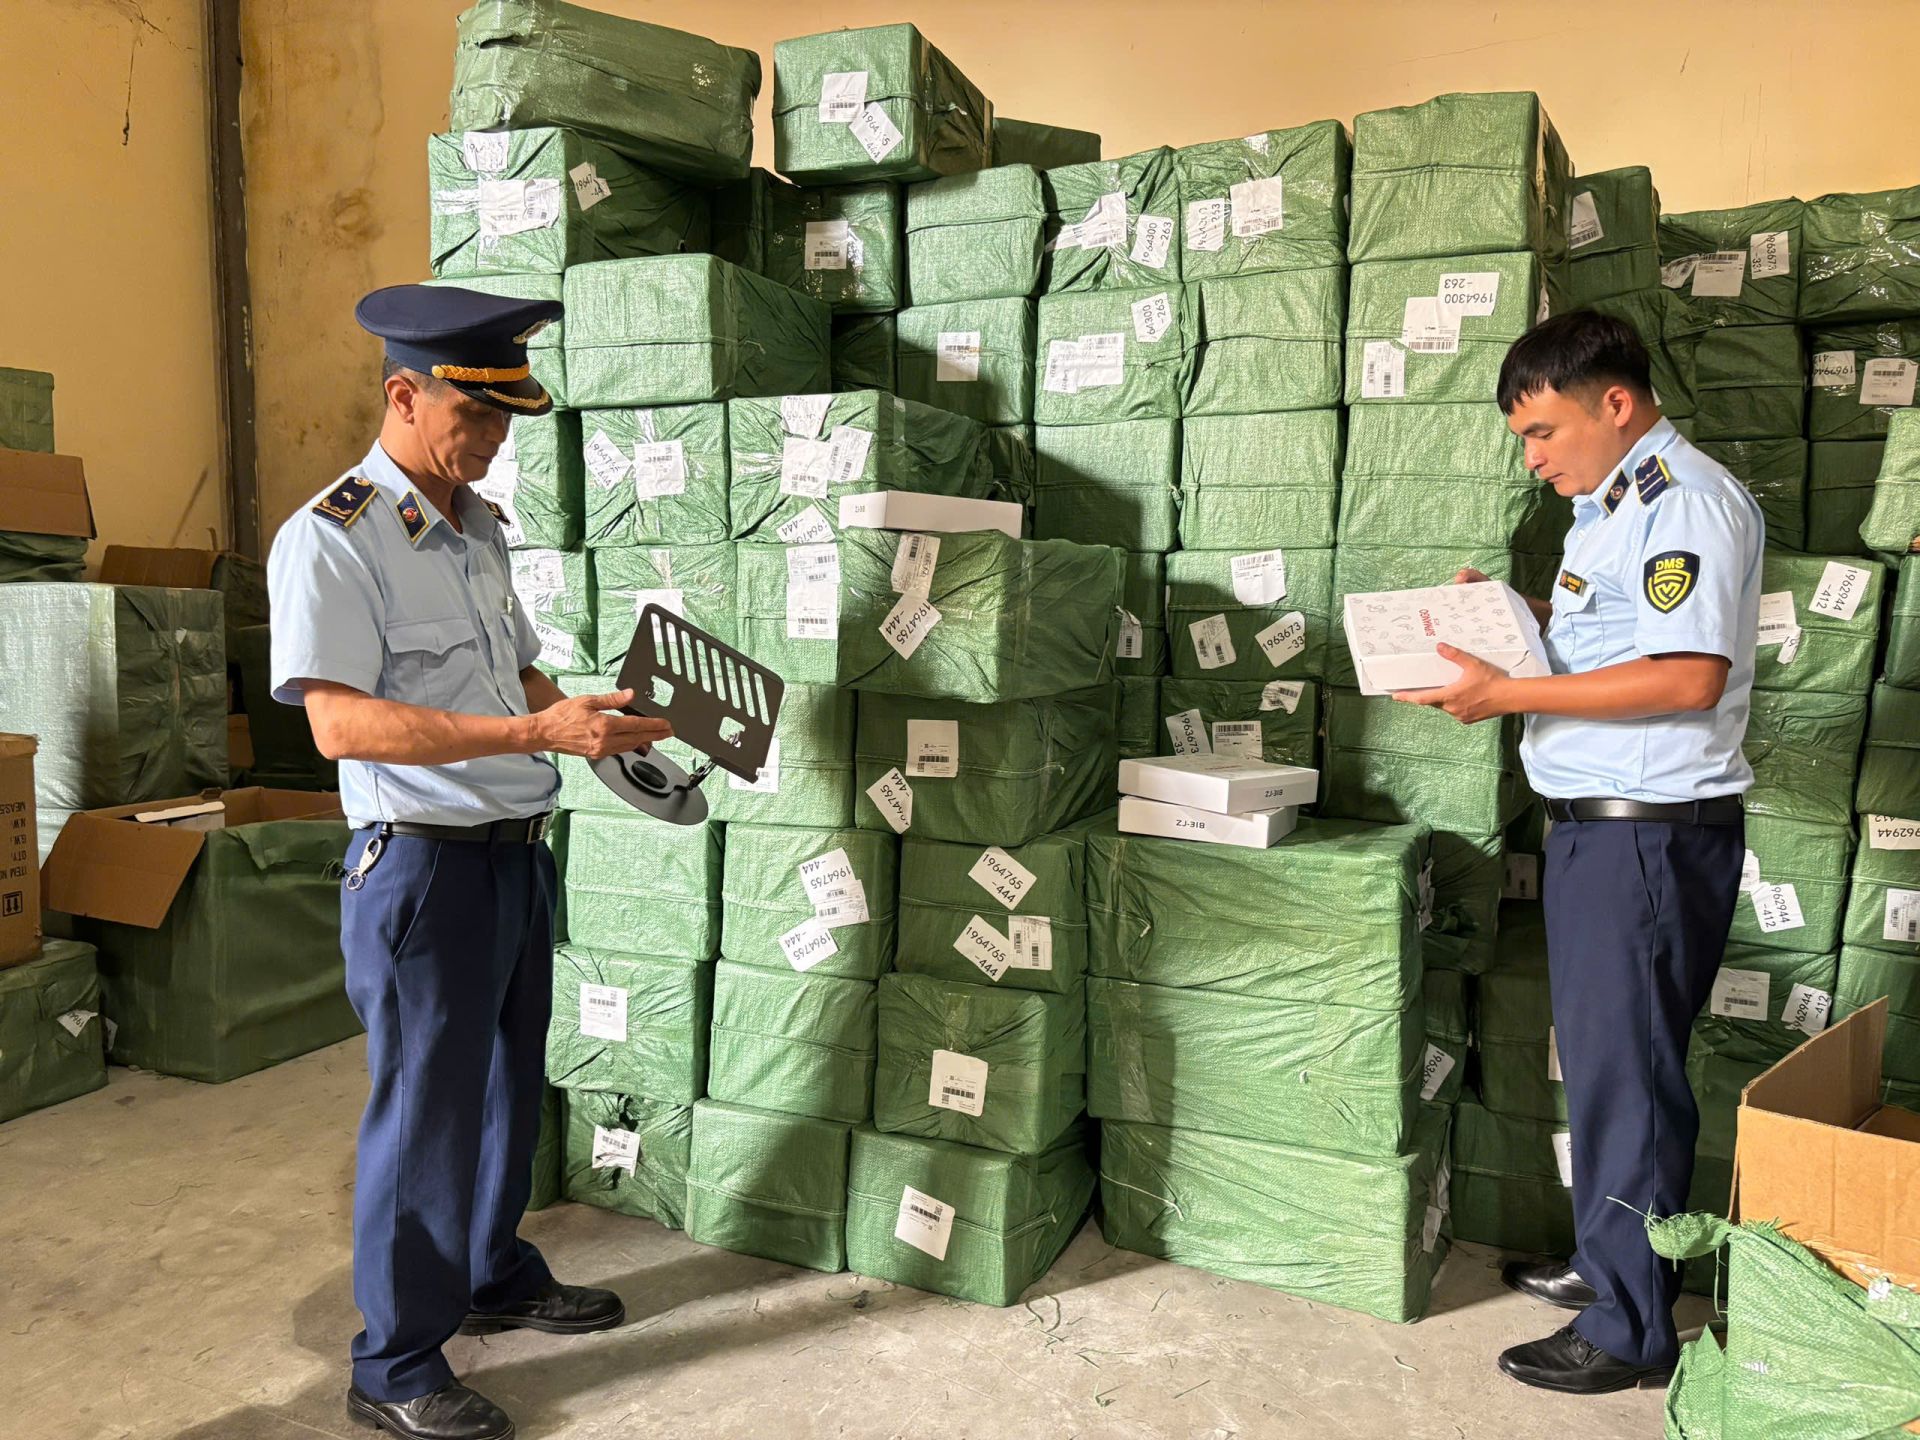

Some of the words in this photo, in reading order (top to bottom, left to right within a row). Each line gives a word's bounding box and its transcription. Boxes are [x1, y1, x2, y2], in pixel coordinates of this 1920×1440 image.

[1160, 220, 1172, 249] -263
[1443, 278, 1474, 290] -263
[1157, 297, 1168, 325] -263
[1444, 292, 1495, 305] 1964300
[780, 517, 805, 537] -444
[1655, 557, 1686, 572] DMS
[1815, 582, 1833, 610] -412
[1831, 568, 1859, 612] 1962944
[884, 610, 906, 637] -444
[896, 601, 933, 646] 1964765
[1261, 620, 1302, 652] 1963673
[1172, 734, 1186, 756] -33
[1180, 711, 1200, 755] 1963673
[890, 771, 912, 798] -444
[801, 859, 827, 875] -444
[809, 864, 852, 891] 1964765
[982, 851, 1025, 891] 1964765
[990, 879, 1017, 904] -444
[1762, 902, 1777, 929] -412
[784, 930, 807, 948] -444
[793, 931, 831, 961] 1964765
[965, 925, 1007, 963] 1964765
[973, 954, 999, 979] -444
[1814, 994, 1831, 1020] -412
